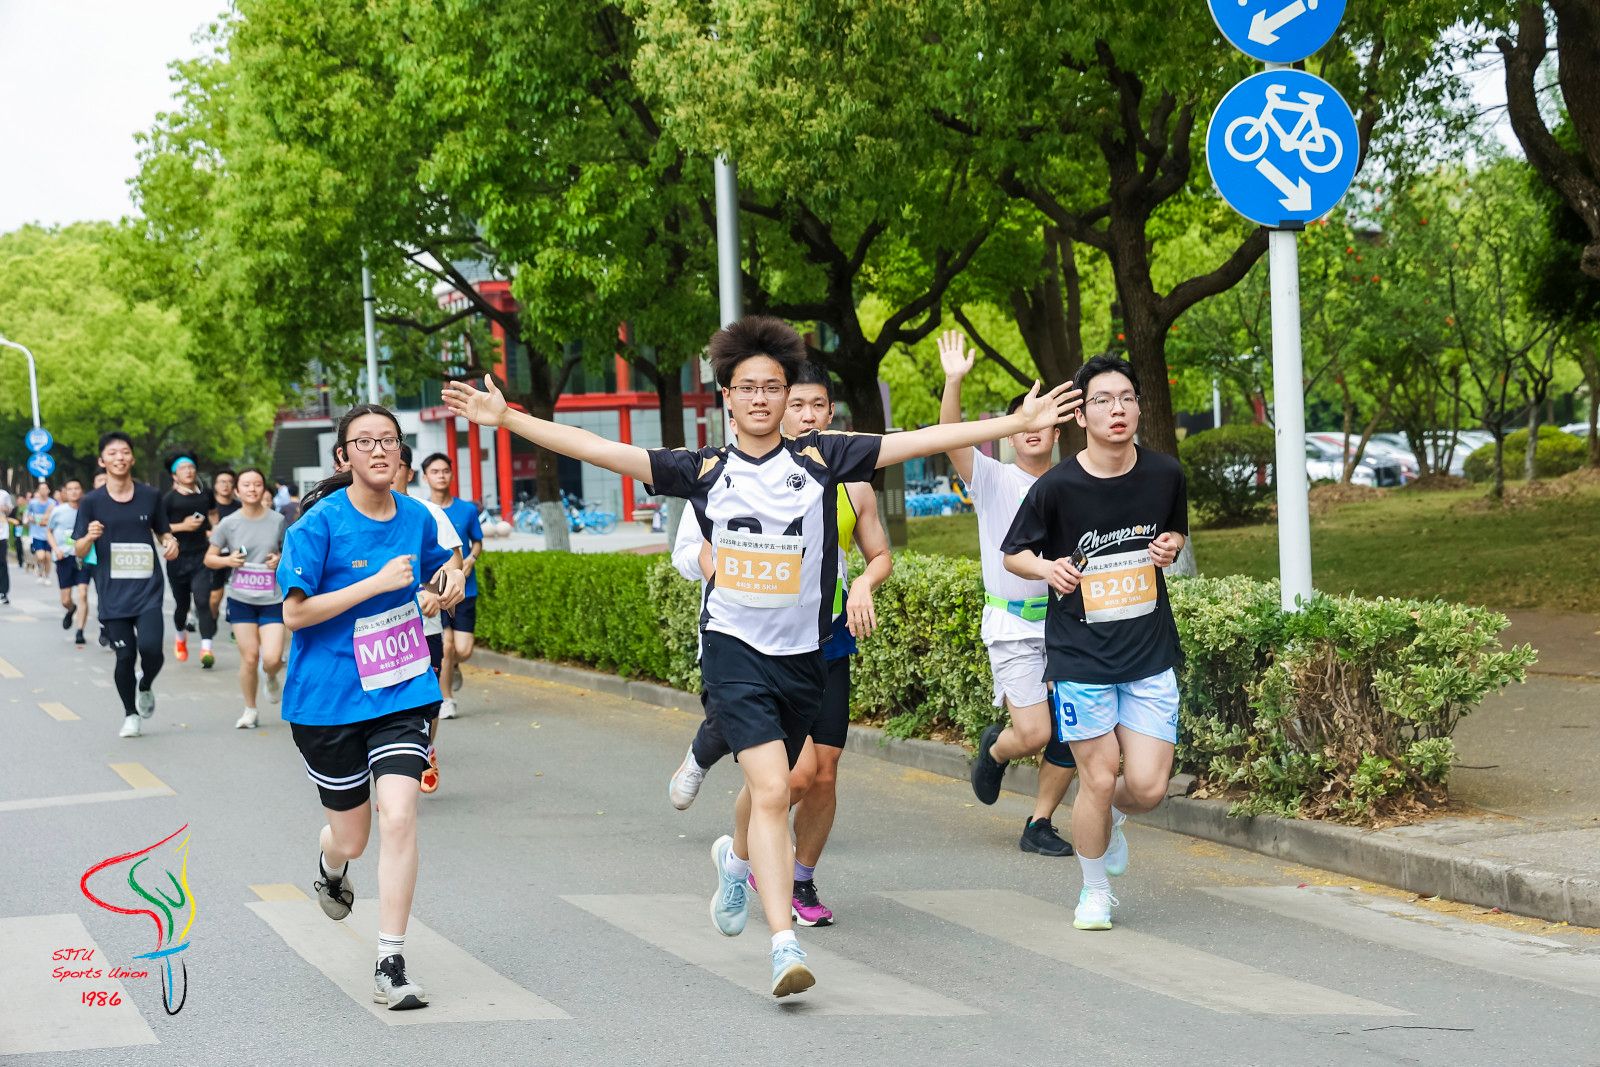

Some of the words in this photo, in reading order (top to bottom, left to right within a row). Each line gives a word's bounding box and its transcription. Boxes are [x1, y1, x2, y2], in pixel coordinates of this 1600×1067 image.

[115, 554, 150, 566] G032
[725, 556, 790, 581] B126
[236, 573, 272, 586] M003
[1090, 573, 1149, 599] B201
[358, 626, 420, 665] M001
[1063, 702, 1078, 727] 9
